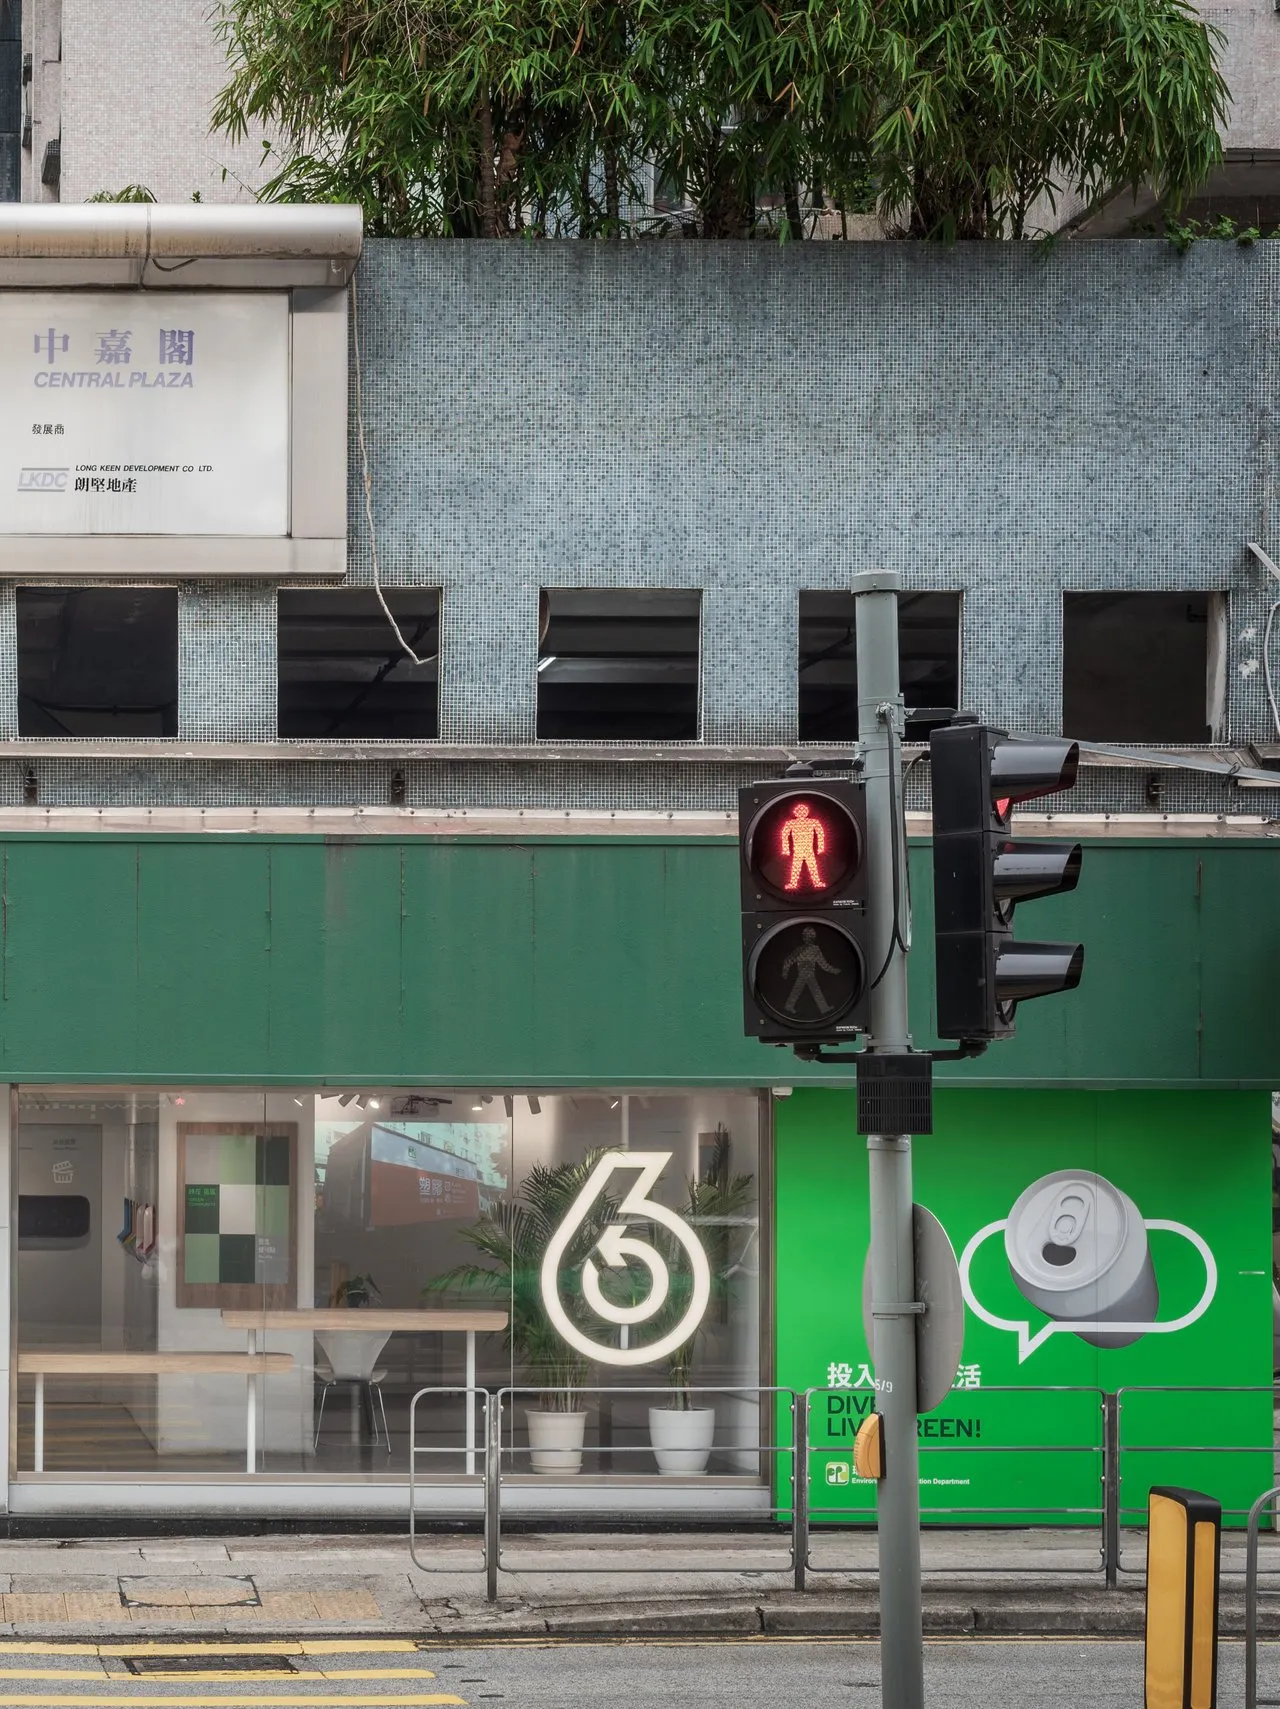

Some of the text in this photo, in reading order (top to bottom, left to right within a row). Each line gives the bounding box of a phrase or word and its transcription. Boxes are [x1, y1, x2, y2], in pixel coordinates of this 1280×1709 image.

[34, 328, 195, 365] 中嘉閣
[34, 372, 194, 388] CENTRAL PLAZA
[31, 424, 65, 435] 發展商
[182, 465, 194, 473] CO
[18, 471, 68, 488] LKDC
[74, 477, 137, 493] 朗堅地產
[933, 1478, 970, 1486] Department
